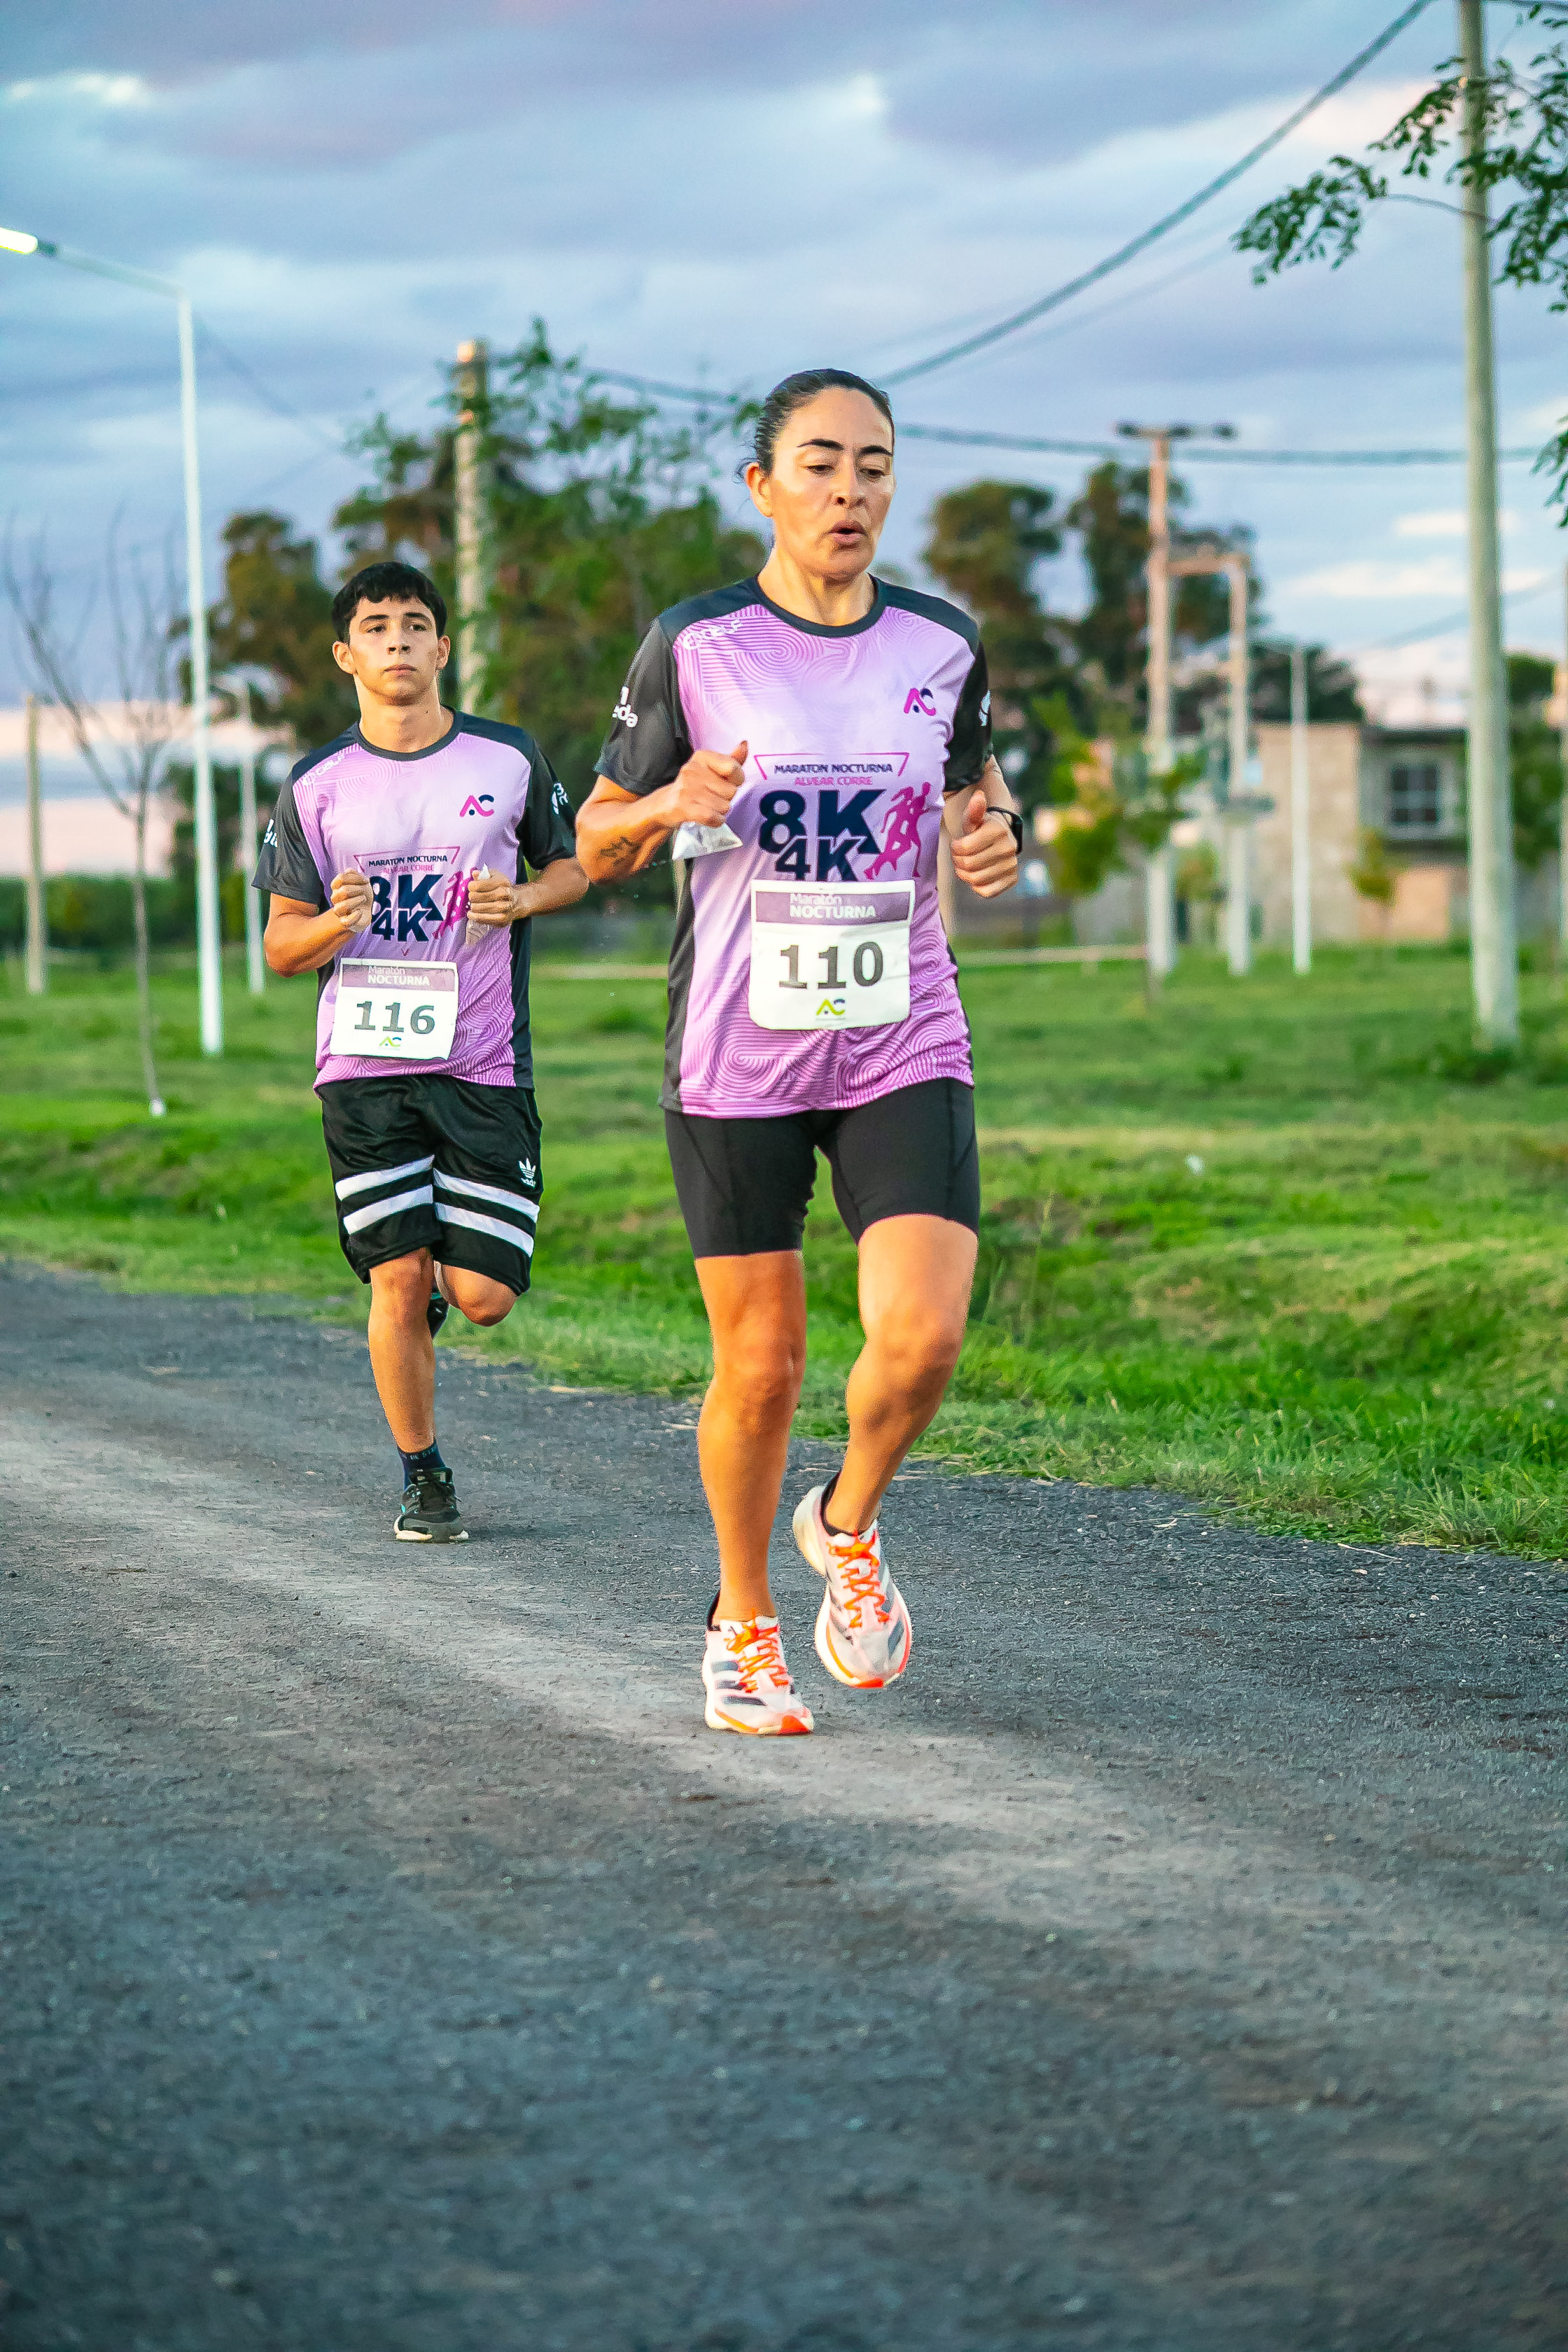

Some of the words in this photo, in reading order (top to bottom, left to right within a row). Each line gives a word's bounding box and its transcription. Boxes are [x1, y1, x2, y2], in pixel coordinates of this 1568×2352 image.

[904, 687, 937, 716] AC
[831, 764, 892, 774] NOCTURNA
[459, 794, 494, 818] AC
[759, 790, 887, 855] 8K
[407, 855, 448, 863] NOCTURNA
[774, 839, 858, 881] 4K
[370, 874, 444, 921] 8K
[790, 892, 841, 905] Maratón
[372, 909, 429, 941] 4K
[790, 905, 876, 919] NOCTURNA
[368, 965, 406, 974] Maratón
[779, 941, 883, 989] 110
[368, 974, 430, 986] NOCTURNA
[354, 1001, 435, 1035] 116
